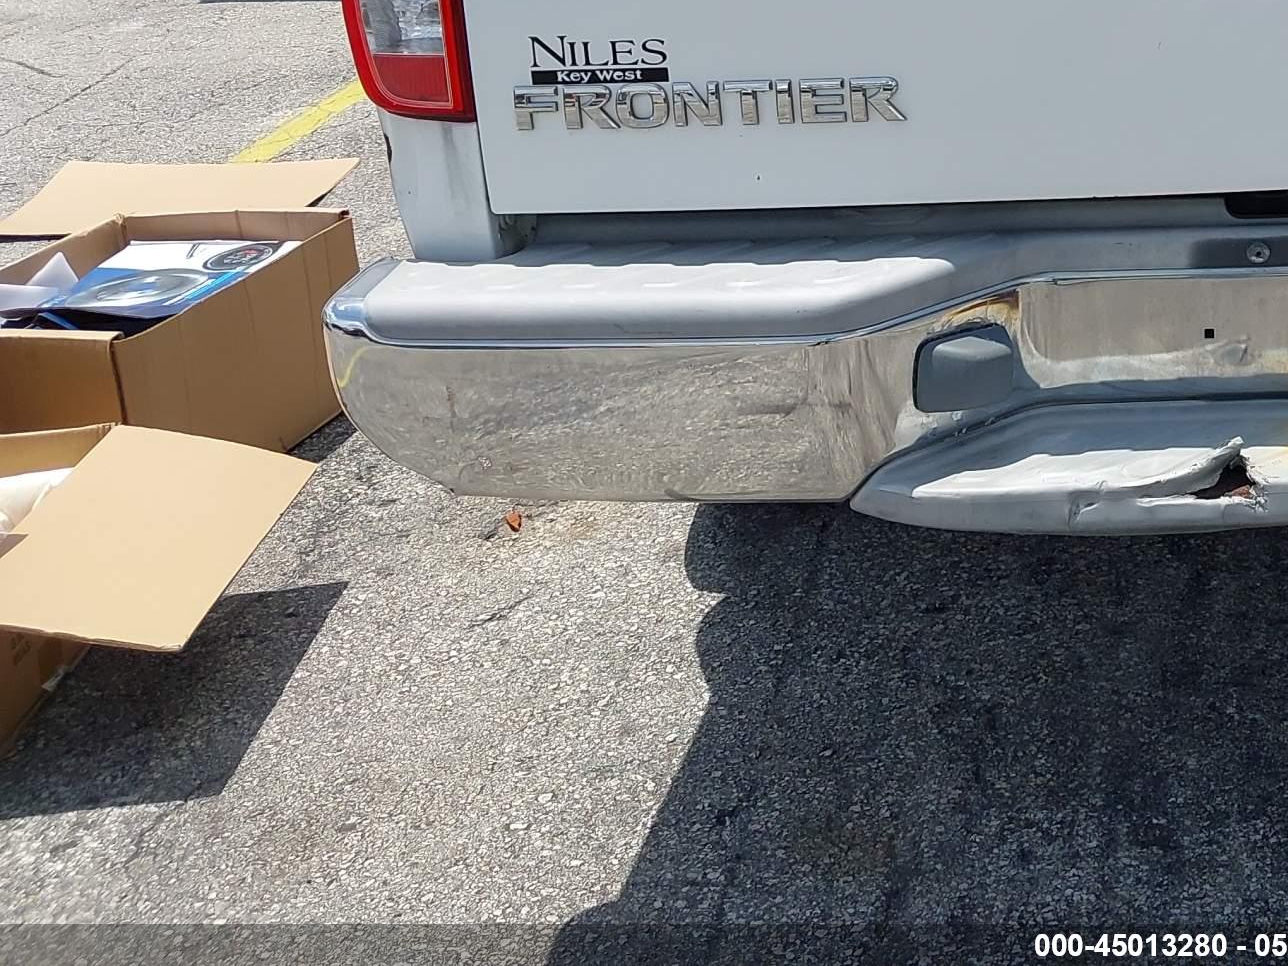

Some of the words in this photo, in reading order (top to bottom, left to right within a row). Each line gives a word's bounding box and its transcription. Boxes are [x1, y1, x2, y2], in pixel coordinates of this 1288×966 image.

[528, 35, 668, 68] NILES
[556, 69, 592, 84] Key
[596, 68, 642, 82] West
[513, 75, 908, 131] FRONTIER
